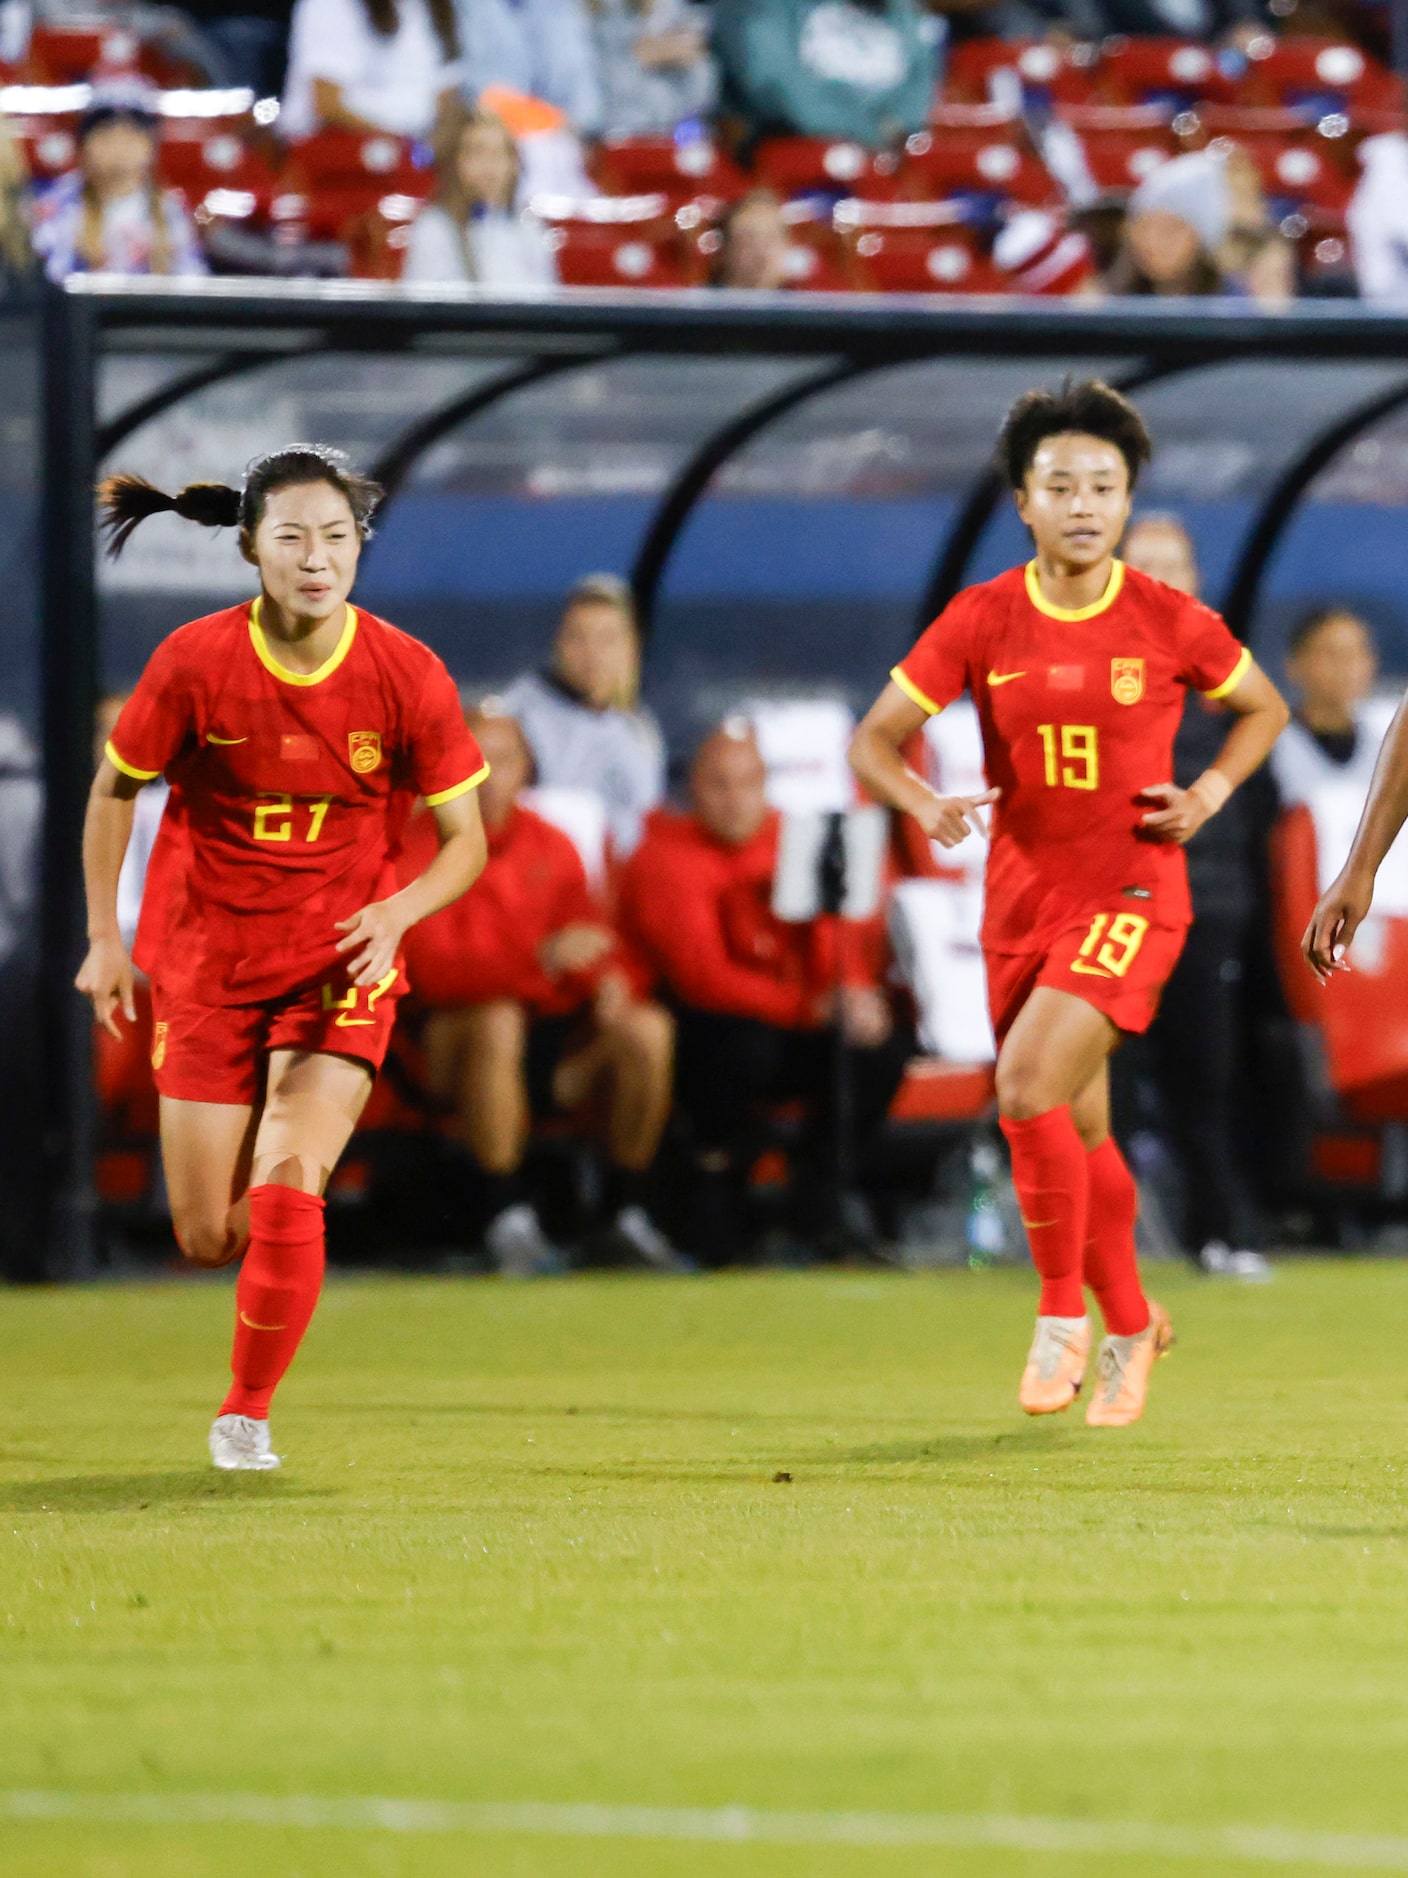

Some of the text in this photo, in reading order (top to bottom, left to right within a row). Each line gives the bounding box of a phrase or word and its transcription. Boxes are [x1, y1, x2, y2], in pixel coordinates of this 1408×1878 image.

[1036, 724, 1098, 790] 19
[253, 791, 335, 842] 27
[1078, 912, 1151, 977] 19
